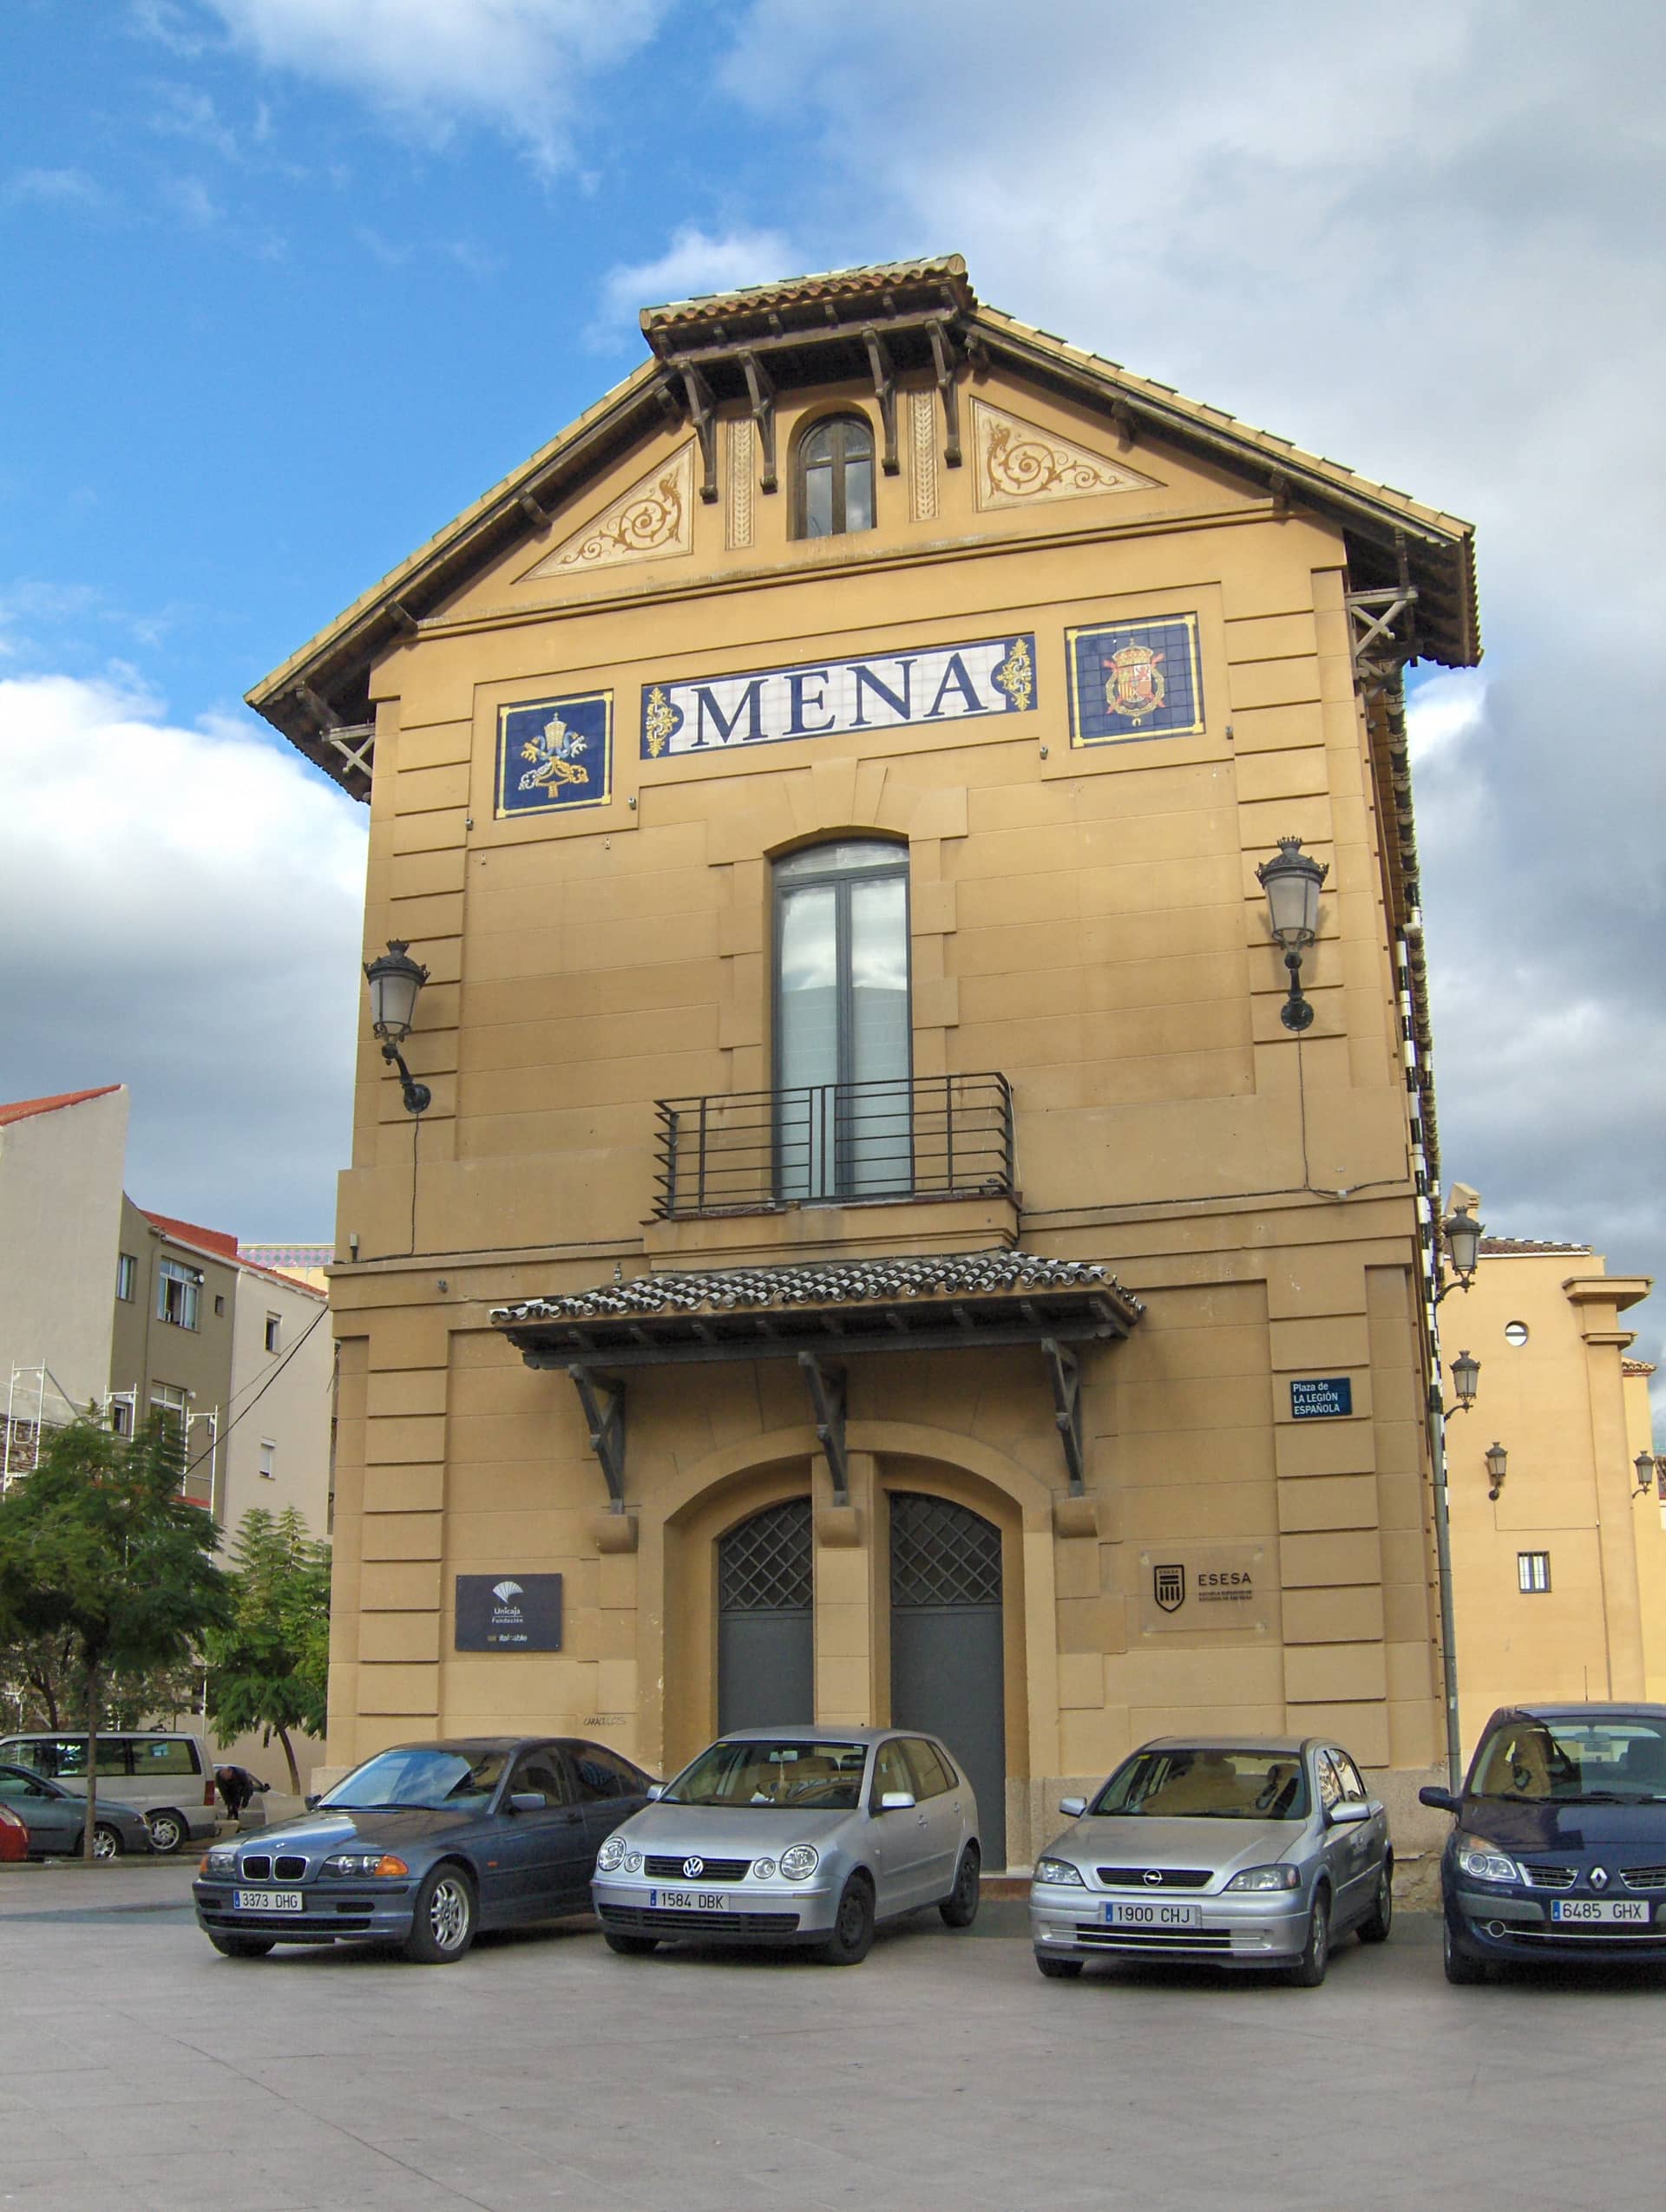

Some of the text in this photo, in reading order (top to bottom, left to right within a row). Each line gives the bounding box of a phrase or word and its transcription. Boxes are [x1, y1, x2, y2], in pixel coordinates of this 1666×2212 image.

[690, 651, 989, 747] MENA
[1293, 1381, 1329, 1392] Plaza de
[1294, 1391, 1339, 1404] LA LEGIÓN
[1294, 1402, 1341, 1415] ESPAÑOLA
[1198, 1572, 1252, 1586] ESESA
[494, 1606, 521, 1616] Unicaja
[243, 1893, 269, 1907] 3373
[275, 1895, 298, 1908] DHG
[661, 1893, 724, 1909] 1584 DBK
[1118, 1907, 1190, 1923] 1900 CHJ
[1563, 1903, 1642, 1919] 6485 GHX
